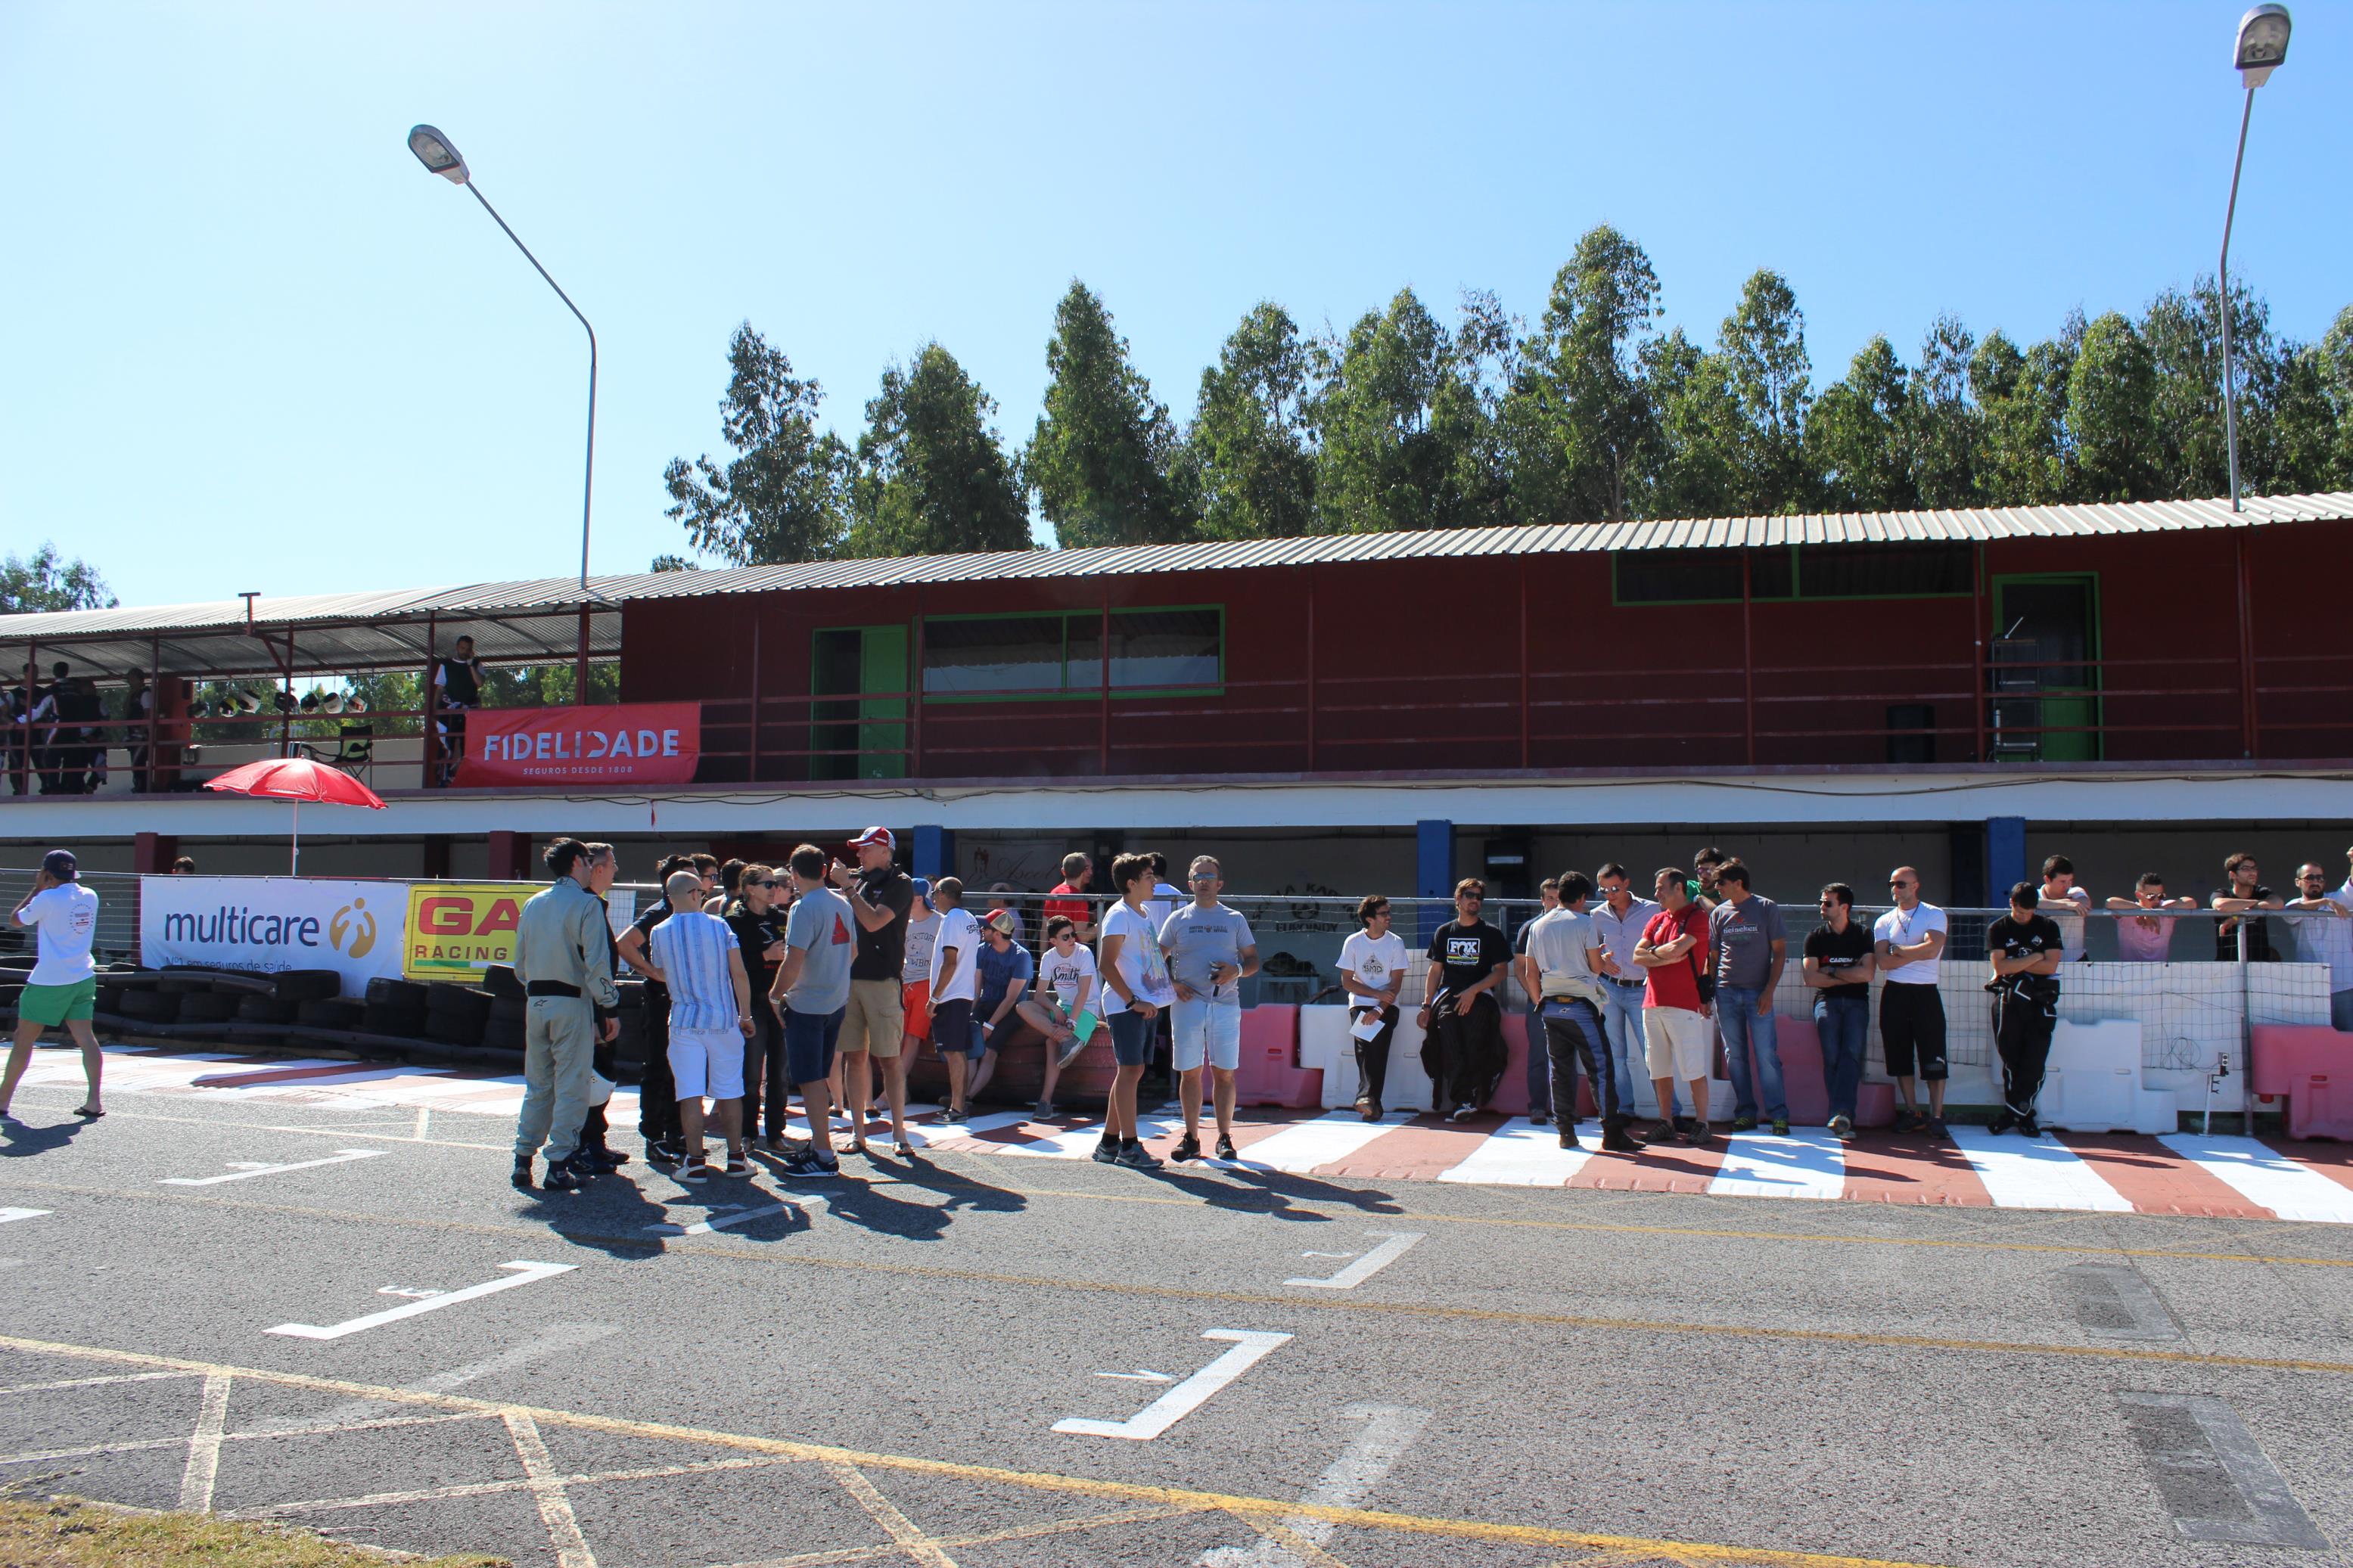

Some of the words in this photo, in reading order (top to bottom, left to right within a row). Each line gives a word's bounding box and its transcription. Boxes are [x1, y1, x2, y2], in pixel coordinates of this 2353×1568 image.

[484, 729, 679, 760] FIDELIDADE
[523, 767, 567, 775] SEGUROS
[165, 906, 320, 946] multicare
[415, 945, 508, 961] RACING
[1450, 941, 1477, 959] FOX
[247, 959, 261, 971] de
